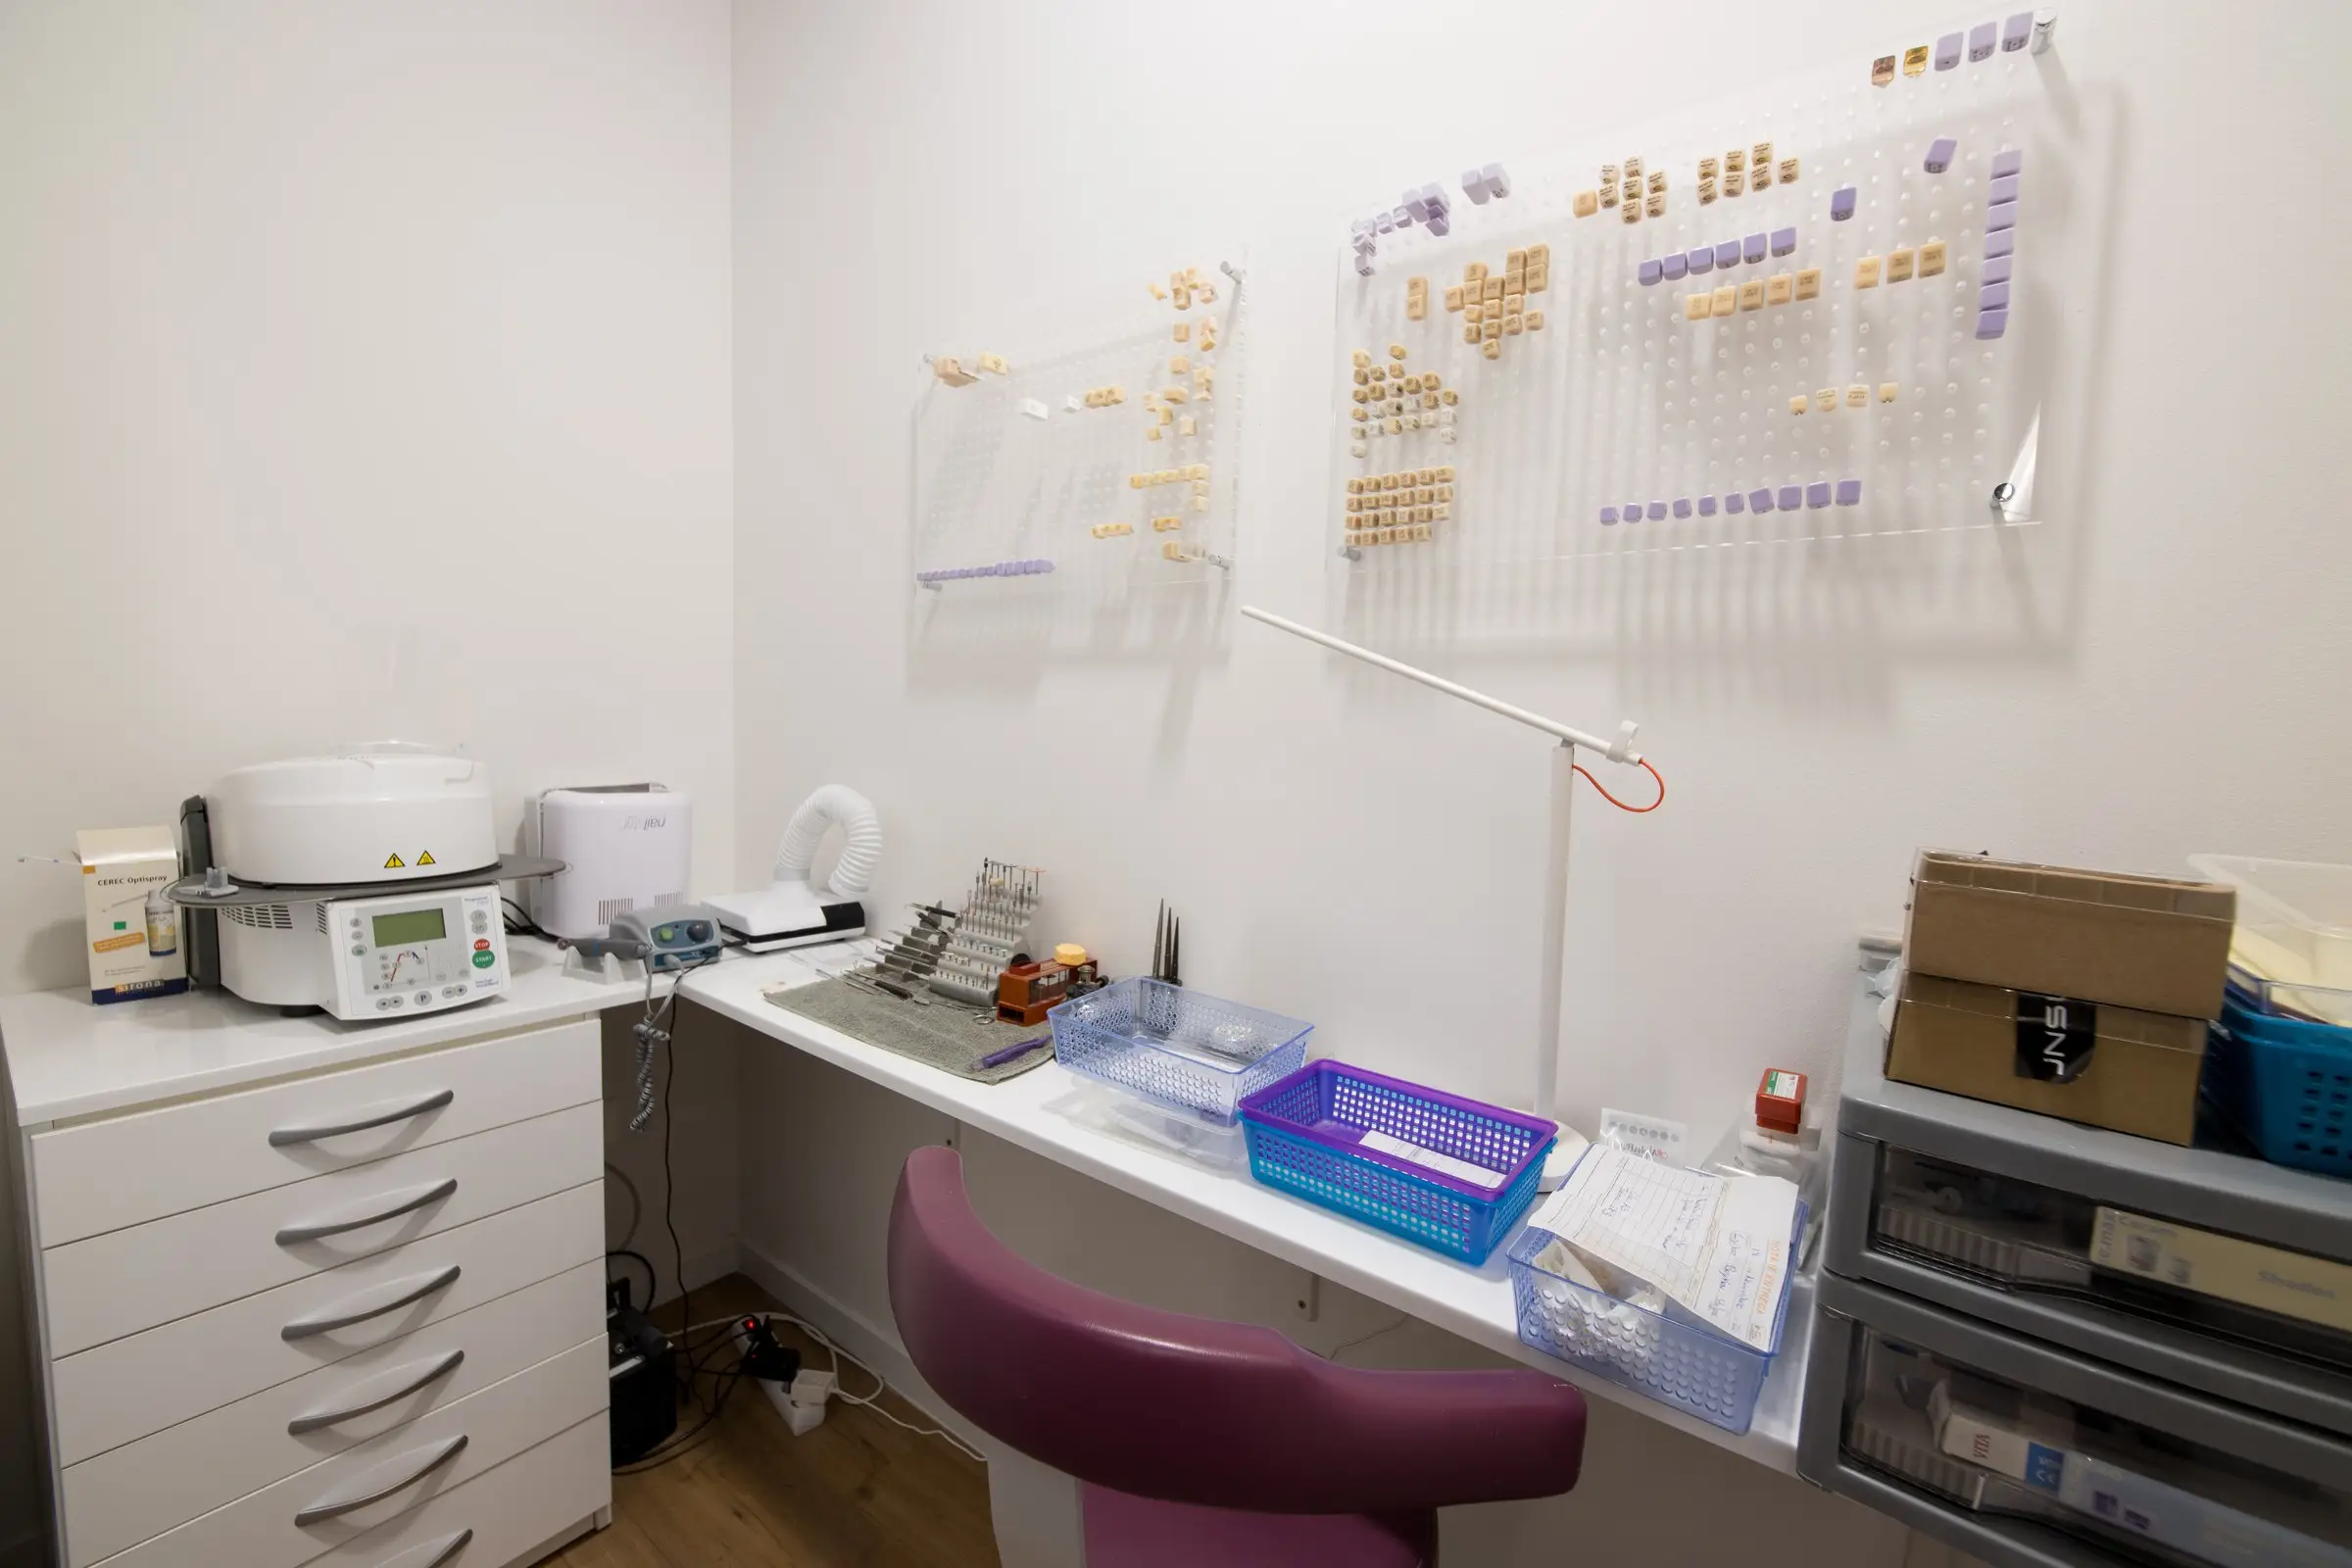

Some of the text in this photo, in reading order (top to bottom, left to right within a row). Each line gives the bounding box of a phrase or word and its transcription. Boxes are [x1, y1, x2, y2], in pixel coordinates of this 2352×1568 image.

[127, 875, 168, 884] Optispray
[474, 941, 490, 950] STOP
[474, 955, 492, 963] START
[1756, 1273, 1775, 1315] ENTREGA
[1973, 1434, 1991, 1459] VITA
